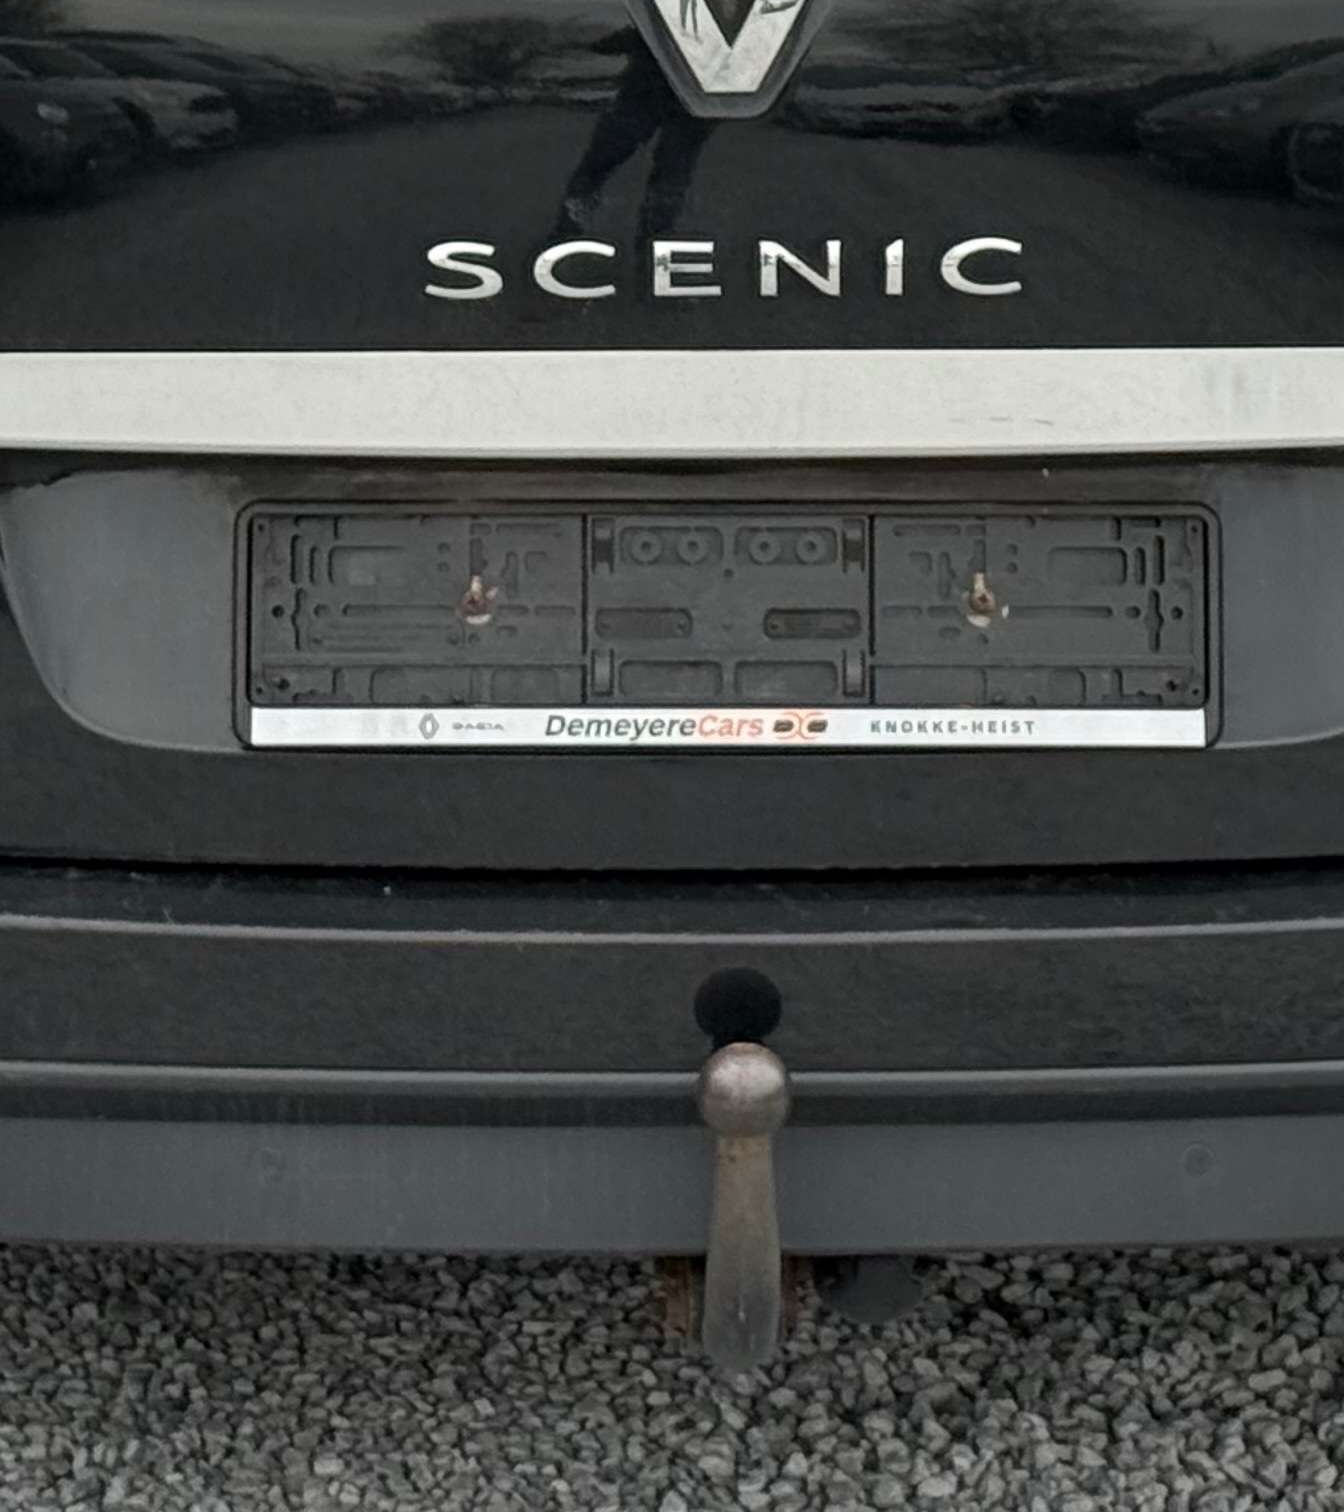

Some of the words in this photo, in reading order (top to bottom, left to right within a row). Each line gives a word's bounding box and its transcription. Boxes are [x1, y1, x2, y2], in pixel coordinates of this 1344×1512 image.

[424, 238, 1022, 300] SCENIC
[545, 714, 764, 741] DemeyereCars
[870, 719, 1036, 735] KNOKKE-HEIST
